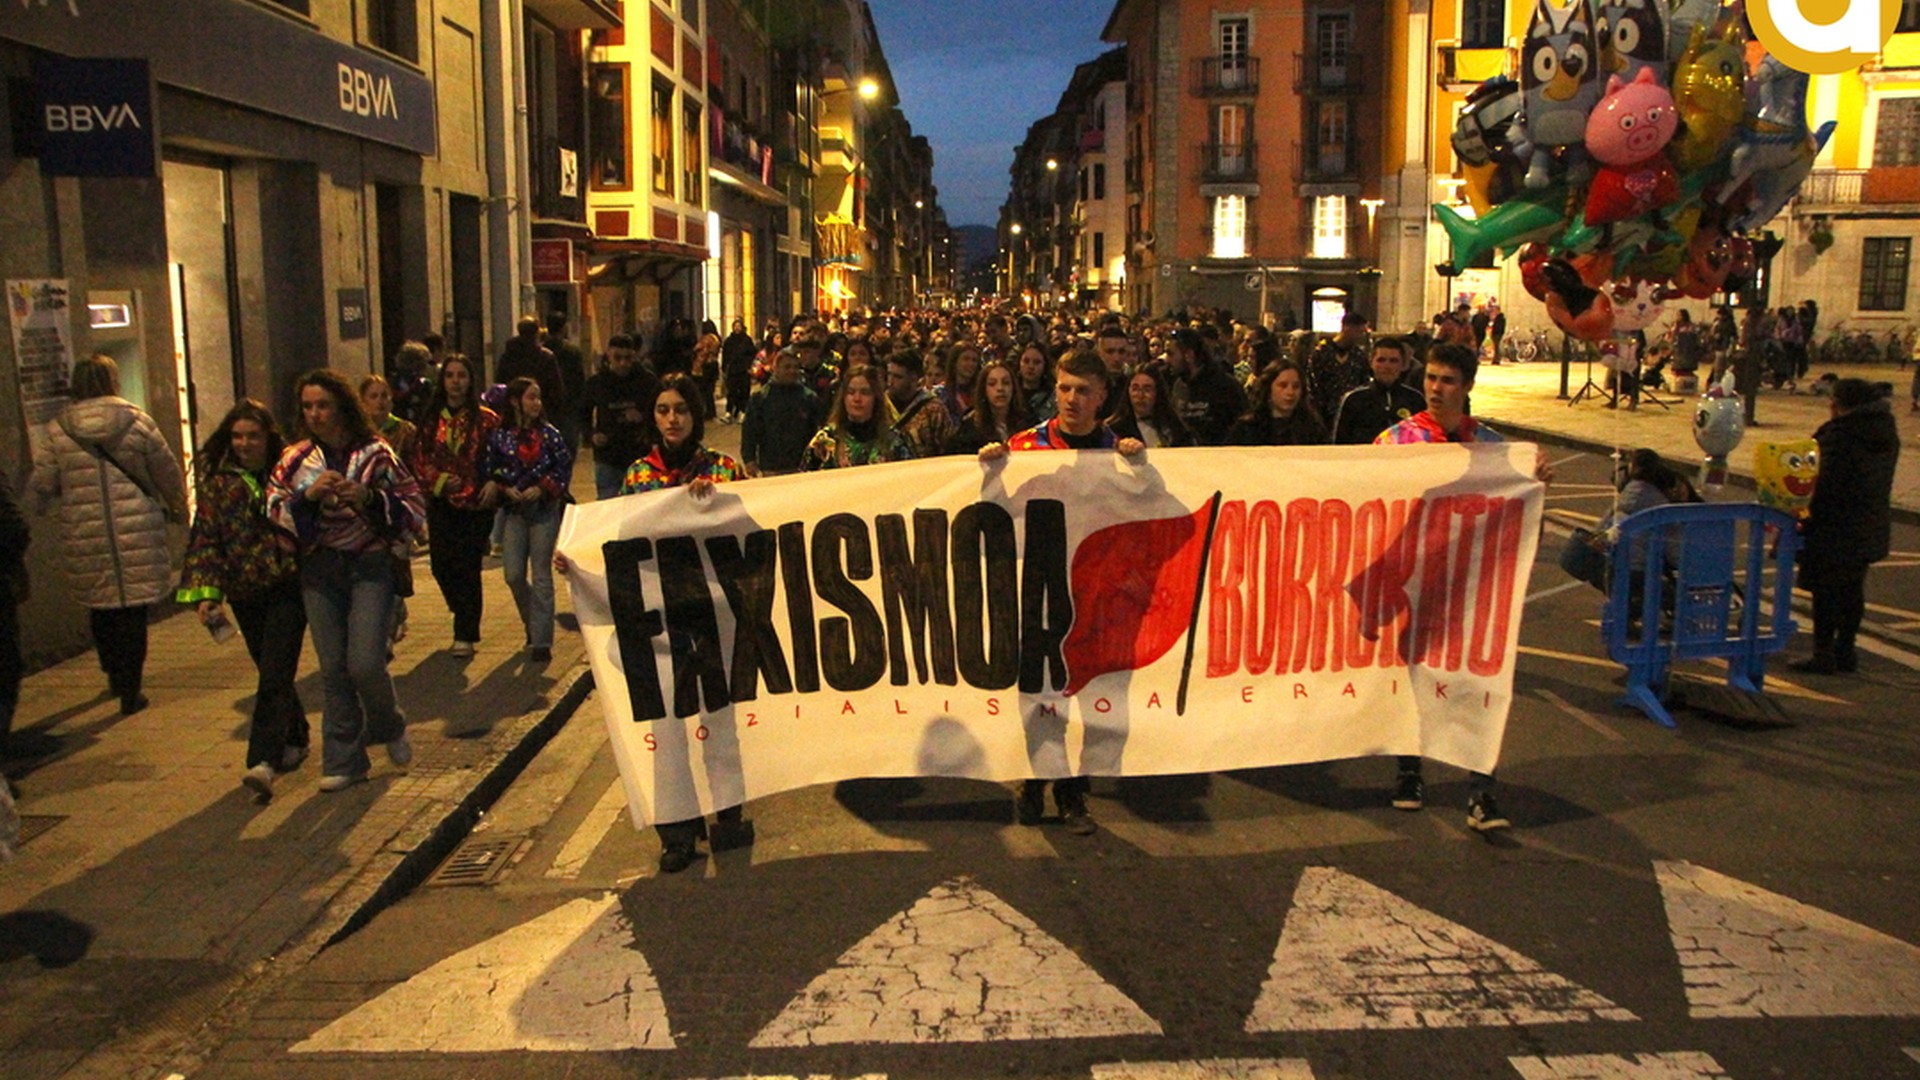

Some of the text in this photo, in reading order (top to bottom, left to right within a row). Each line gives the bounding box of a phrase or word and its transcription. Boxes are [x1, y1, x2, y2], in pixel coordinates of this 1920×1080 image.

[45, 102, 141, 132] BBVA
[338, 62, 398, 120] BBVA
[344, 306, 363, 322] BBVA
[603, 494, 1525, 723] FAXISMOA BORROKATU
[642, 680, 1490, 752] SOZIALISMOA ERAIKI
